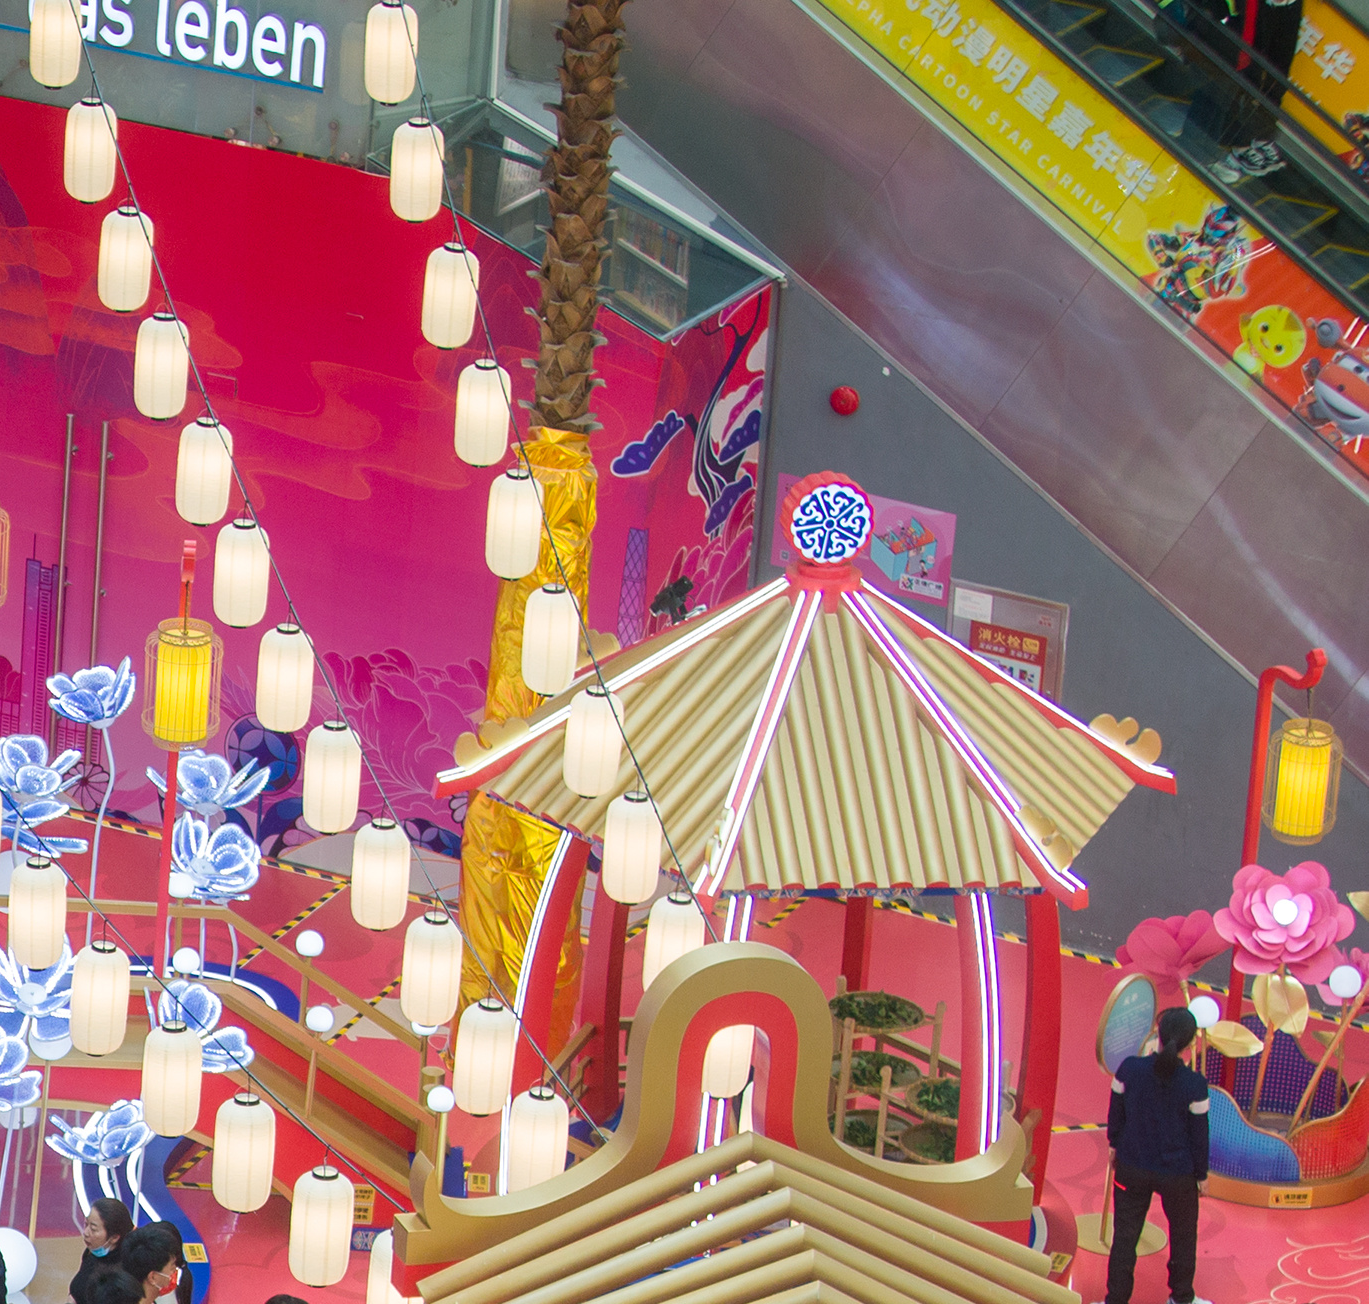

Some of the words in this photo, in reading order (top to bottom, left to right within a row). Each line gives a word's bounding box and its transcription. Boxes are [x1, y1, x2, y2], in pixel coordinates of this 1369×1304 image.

[155, 0, 327, 89] leben
[898, 34, 983, 112] CARTOON
[986, 107, 1033, 155] STAR
[1037, 153, 1122, 236] CARNIVAL
[903, 0, 1158, 202] 动漫明星嘉年华
